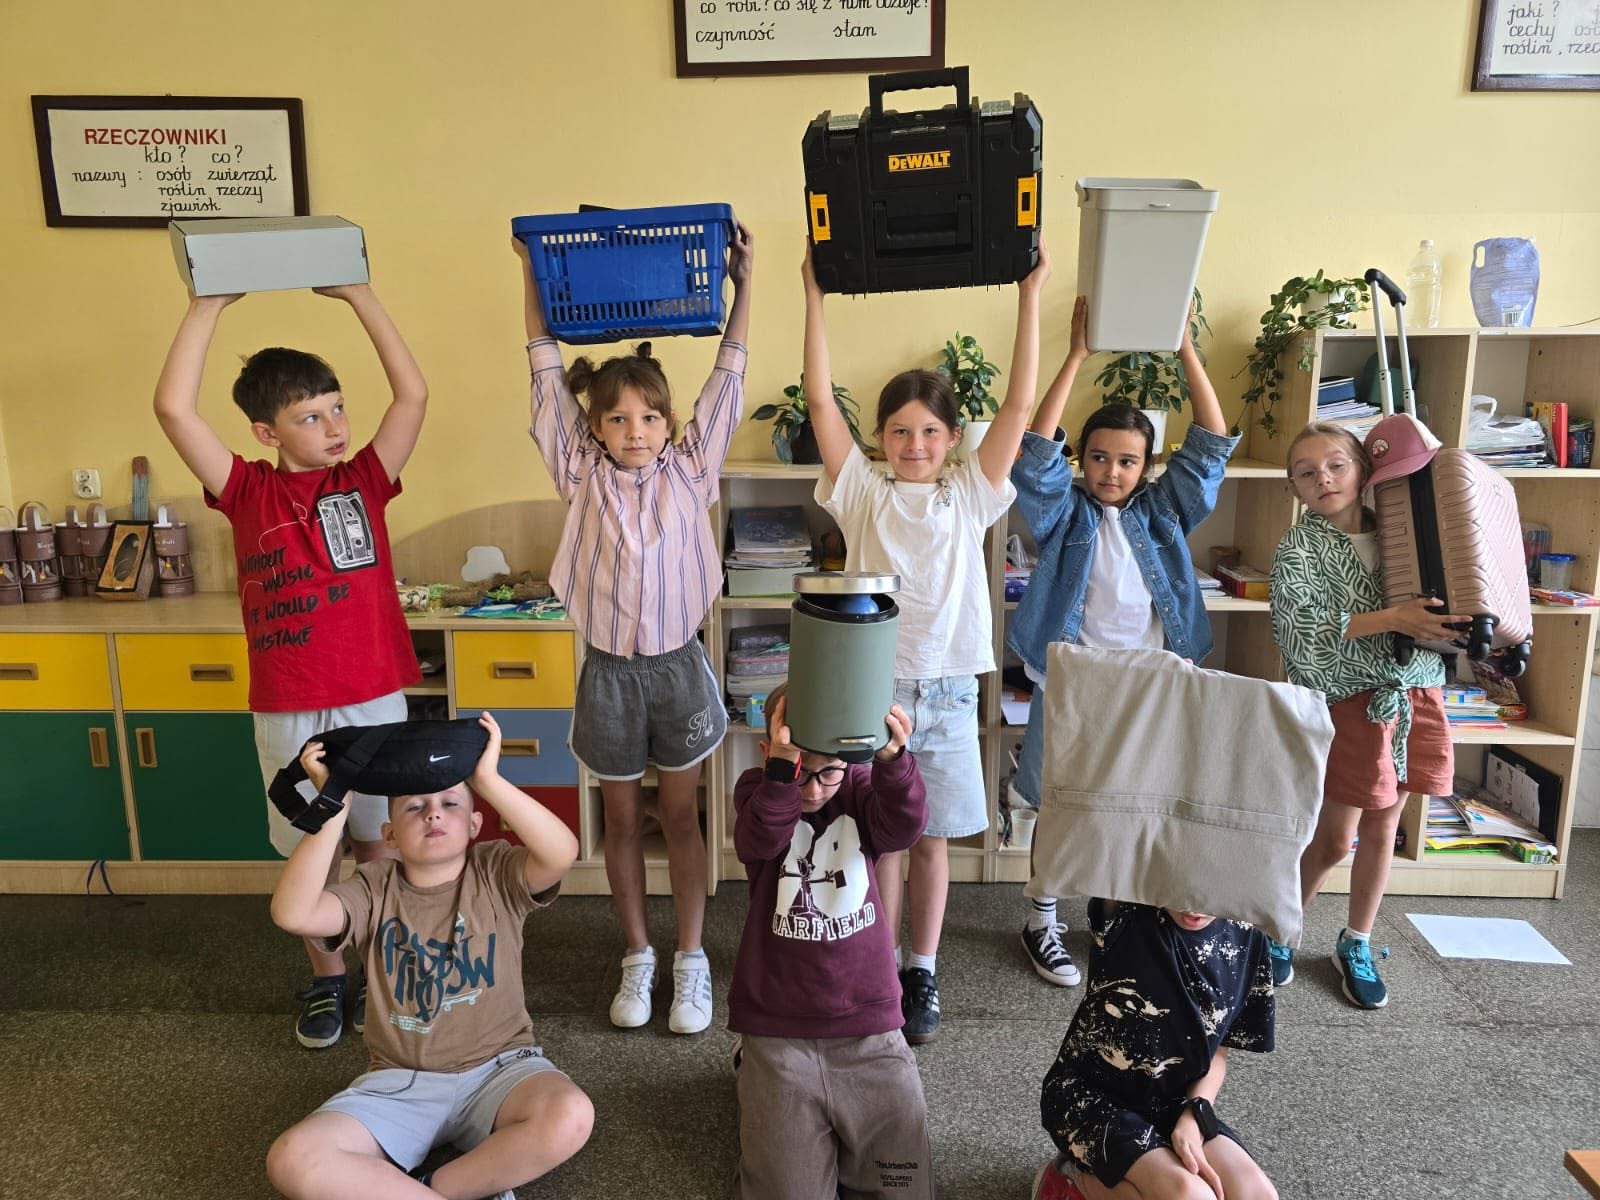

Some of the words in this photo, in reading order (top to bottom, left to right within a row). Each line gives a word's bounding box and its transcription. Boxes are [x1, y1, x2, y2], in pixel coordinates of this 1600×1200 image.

[700, 2, 717, 14] co
[774, 0, 791, 12] co
[695, 21, 776, 51] czynność
[832, 18, 878, 38] stan
[1509, 20, 1555, 43] cechy
[84, 128, 227, 146] RZECZOWNIKI
[71, 170, 127, 188] nazwy
[156, 165, 192, 182] osób
[207, 163, 277, 184] zwierząt
[157, 182, 207, 197] roślin
[216, 186, 263, 204] rzeczy
[160, 197, 222, 217] zjawisk
[263, 563, 314, 592] MUSIC
[264, 594, 319, 621] WOULD
[327, 582, 350, 604] BE
